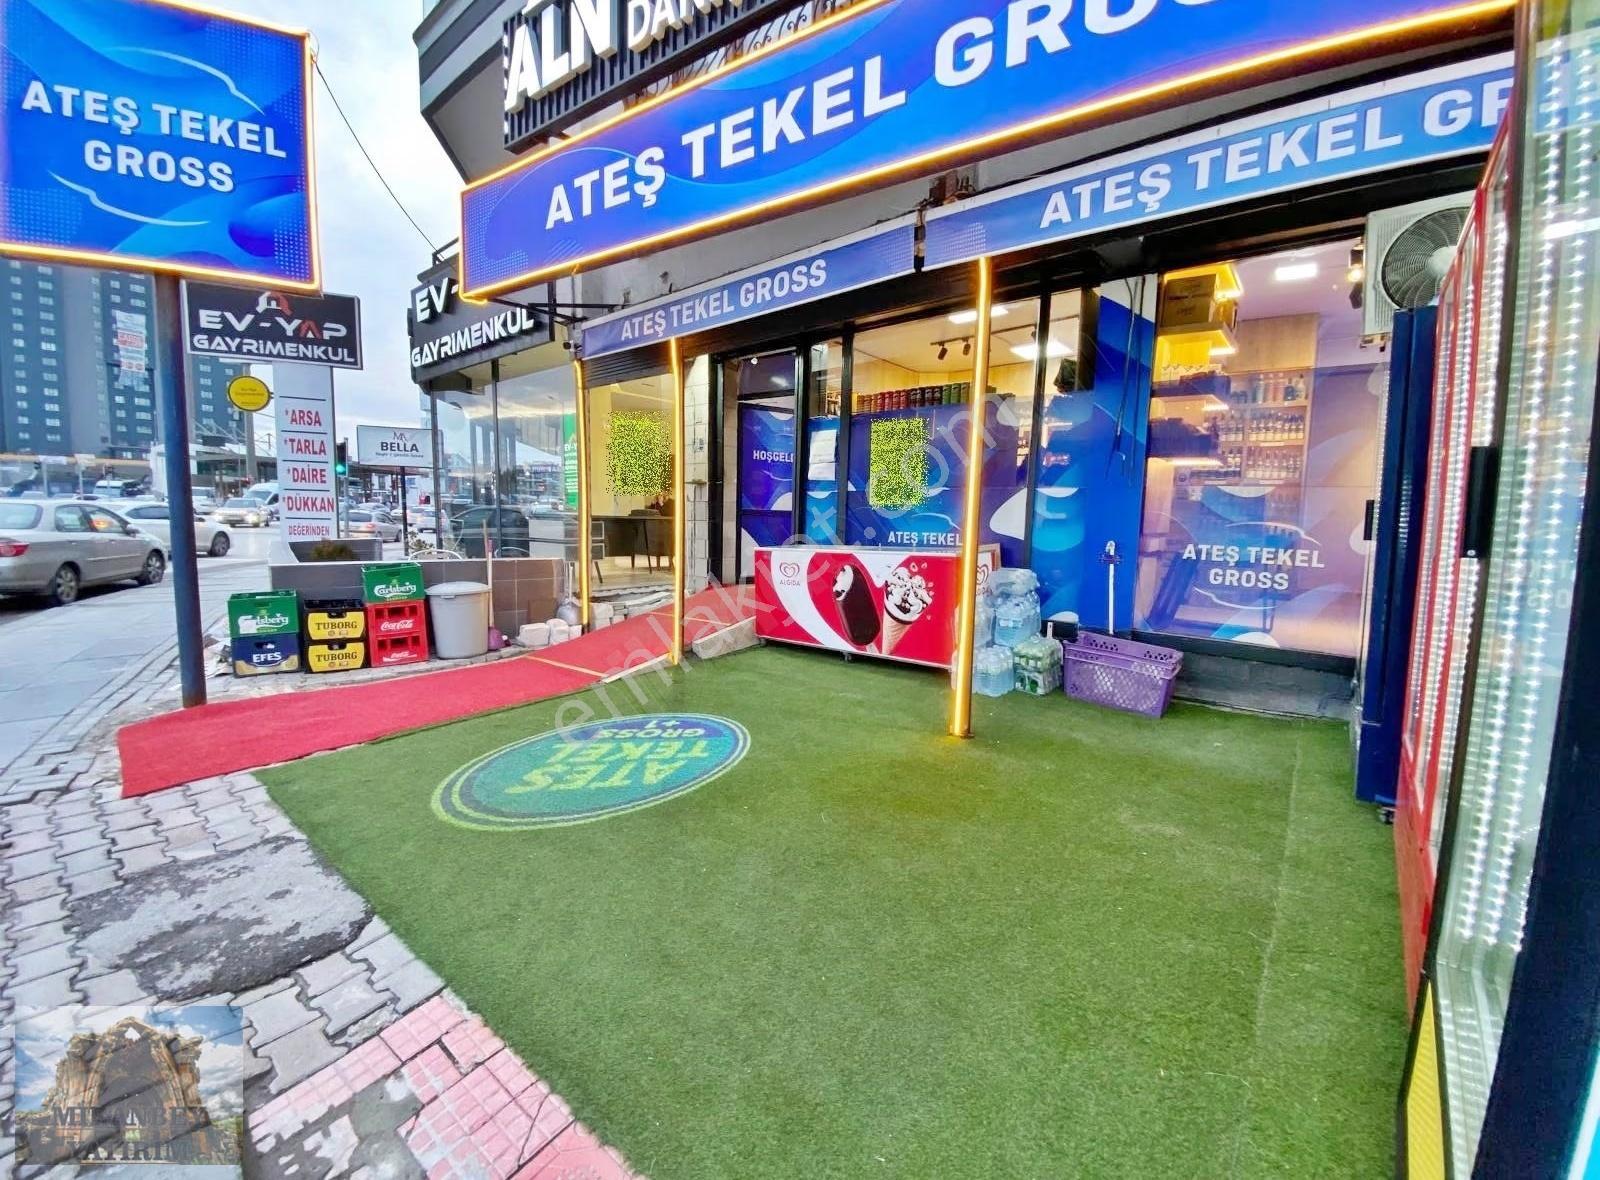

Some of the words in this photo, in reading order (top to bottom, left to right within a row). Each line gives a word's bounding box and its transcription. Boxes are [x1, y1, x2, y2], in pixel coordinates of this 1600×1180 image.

[22, 79, 141, 136] ATEŞ
[151, 103, 288, 158] TEKEL
[545, 144, 666, 230] ATEŞ
[682, 55, 907, 177] TEKEL
[83, 139, 235, 193] GROSS
[1039, 161, 1172, 229] ATEŞ
[1187, 106, 1403, 190] TEKEL
[620, 310, 666, 337] ATEŞ
[669, 290, 735, 328] TEKEL
[739, 258, 828, 308] GROSS
[380, 442, 419, 453] BELLA
[923, 532, 963, 546] TEKEL
[1182, 544, 1240, 567] ATEŞ
[1249, 546, 1325, 569] TEKEL
[1209, 568, 1289, 591] GROSS
[374, 582, 417, 598] Carlsberg
[315, 621, 357, 630] TUBORG
[252, 652, 282, 662] EFES
[315, 651, 357, 662] TUBORG
[599, 727, 706, 739] GROSS
